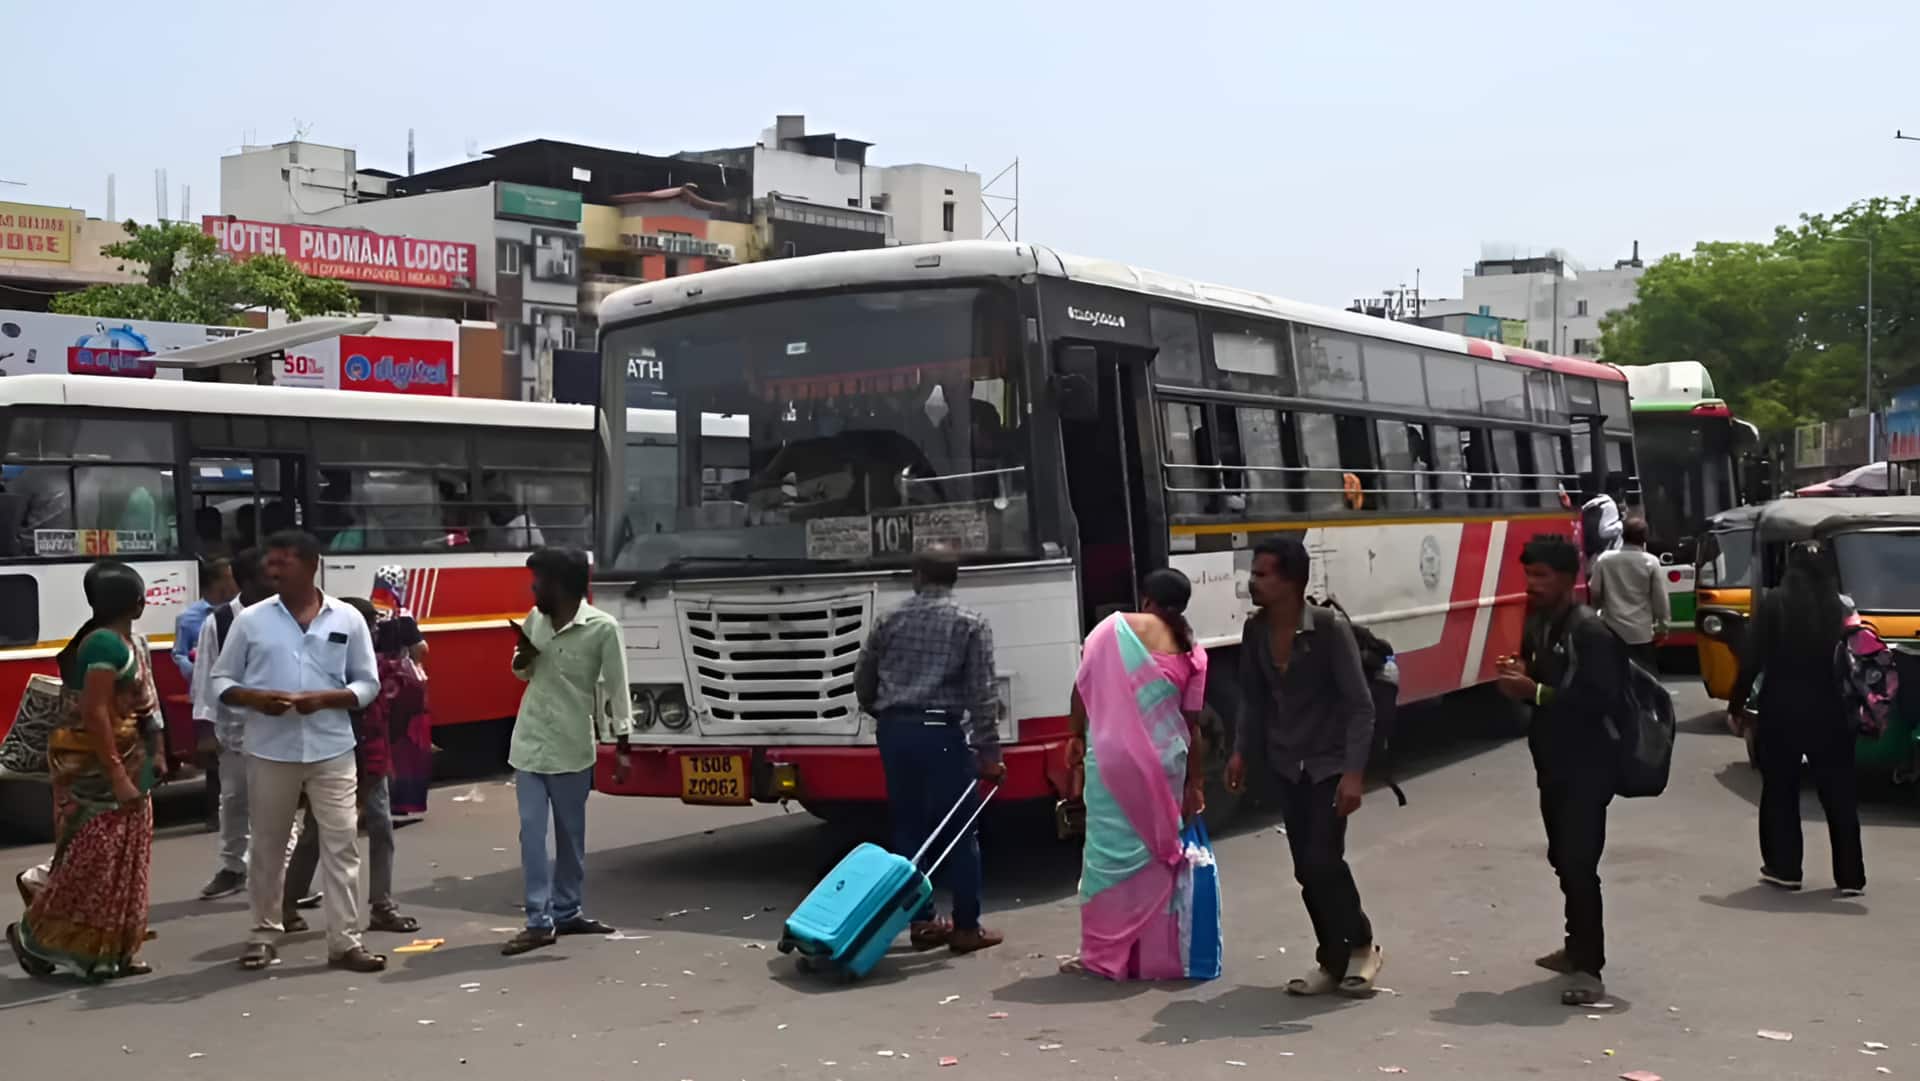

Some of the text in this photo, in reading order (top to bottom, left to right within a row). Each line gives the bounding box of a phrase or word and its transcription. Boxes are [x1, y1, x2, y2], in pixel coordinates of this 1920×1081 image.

[212, 220, 469, 273] HOTEL PADMAJA LODGE
[688, 778, 738, 797] Z0062
